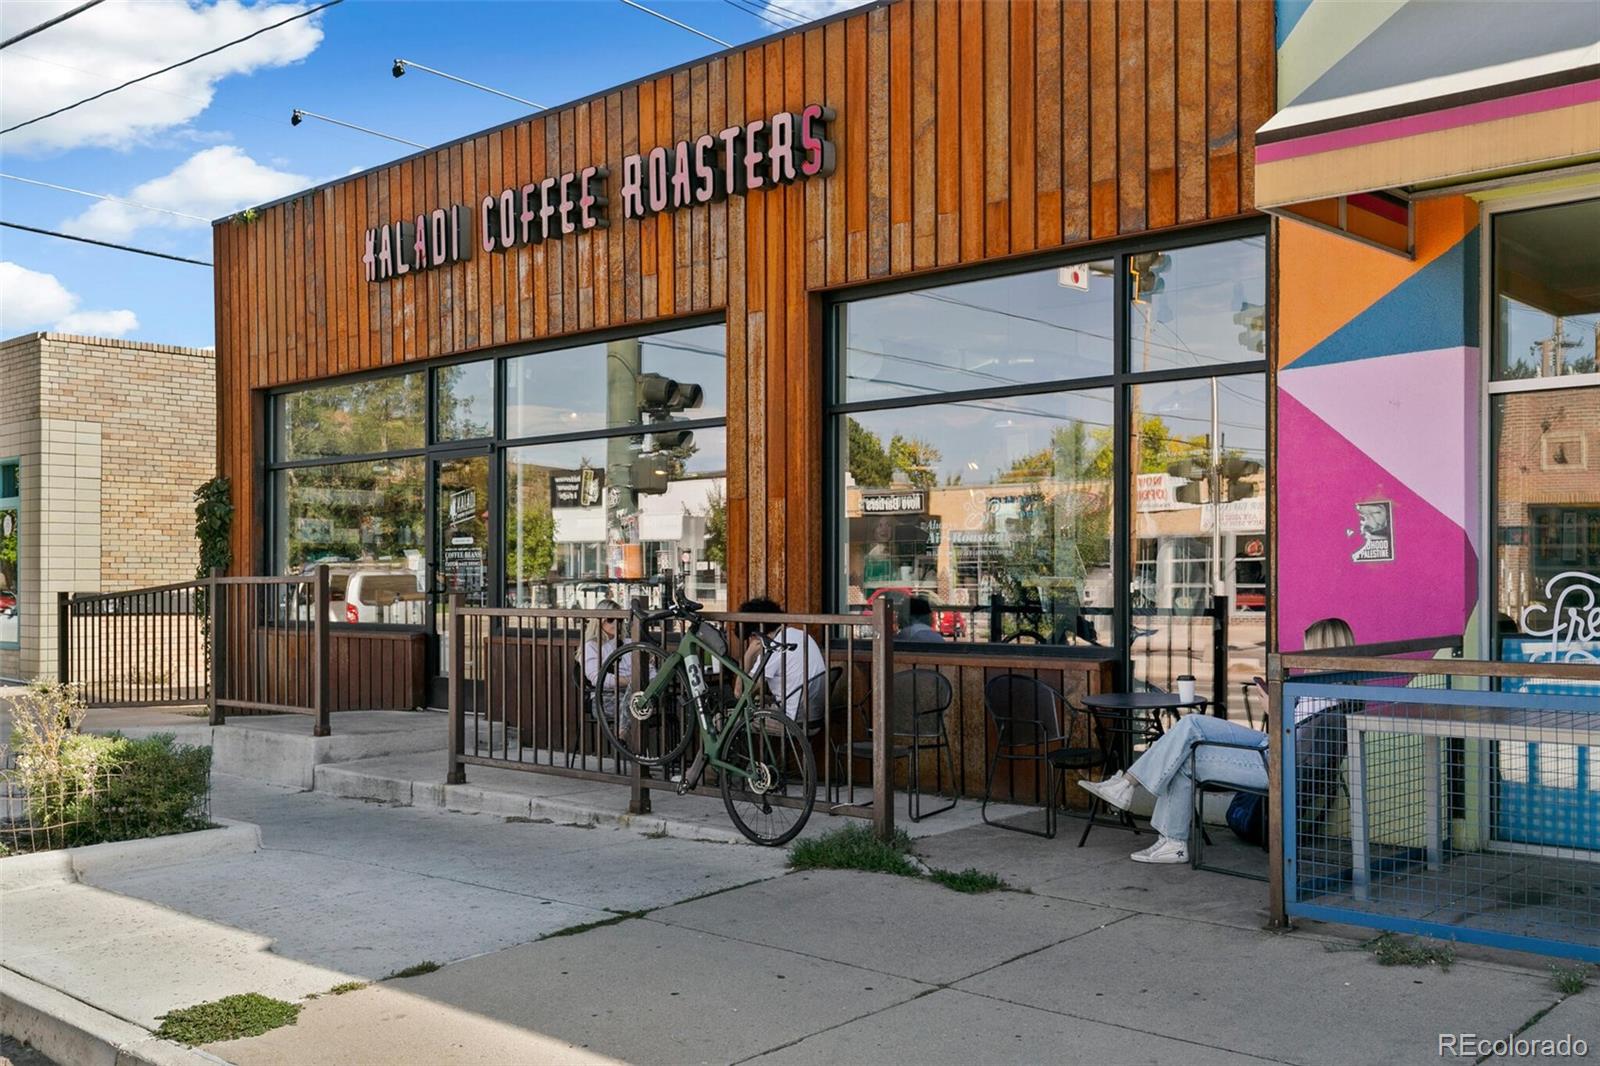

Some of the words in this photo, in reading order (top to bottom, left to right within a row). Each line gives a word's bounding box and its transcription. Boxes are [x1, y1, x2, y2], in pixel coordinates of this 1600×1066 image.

[362, 204, 460, 282] KALADI
[482, 166, 599, 252] COFFEE
[621, 103, 825, 219] ROASTERS
